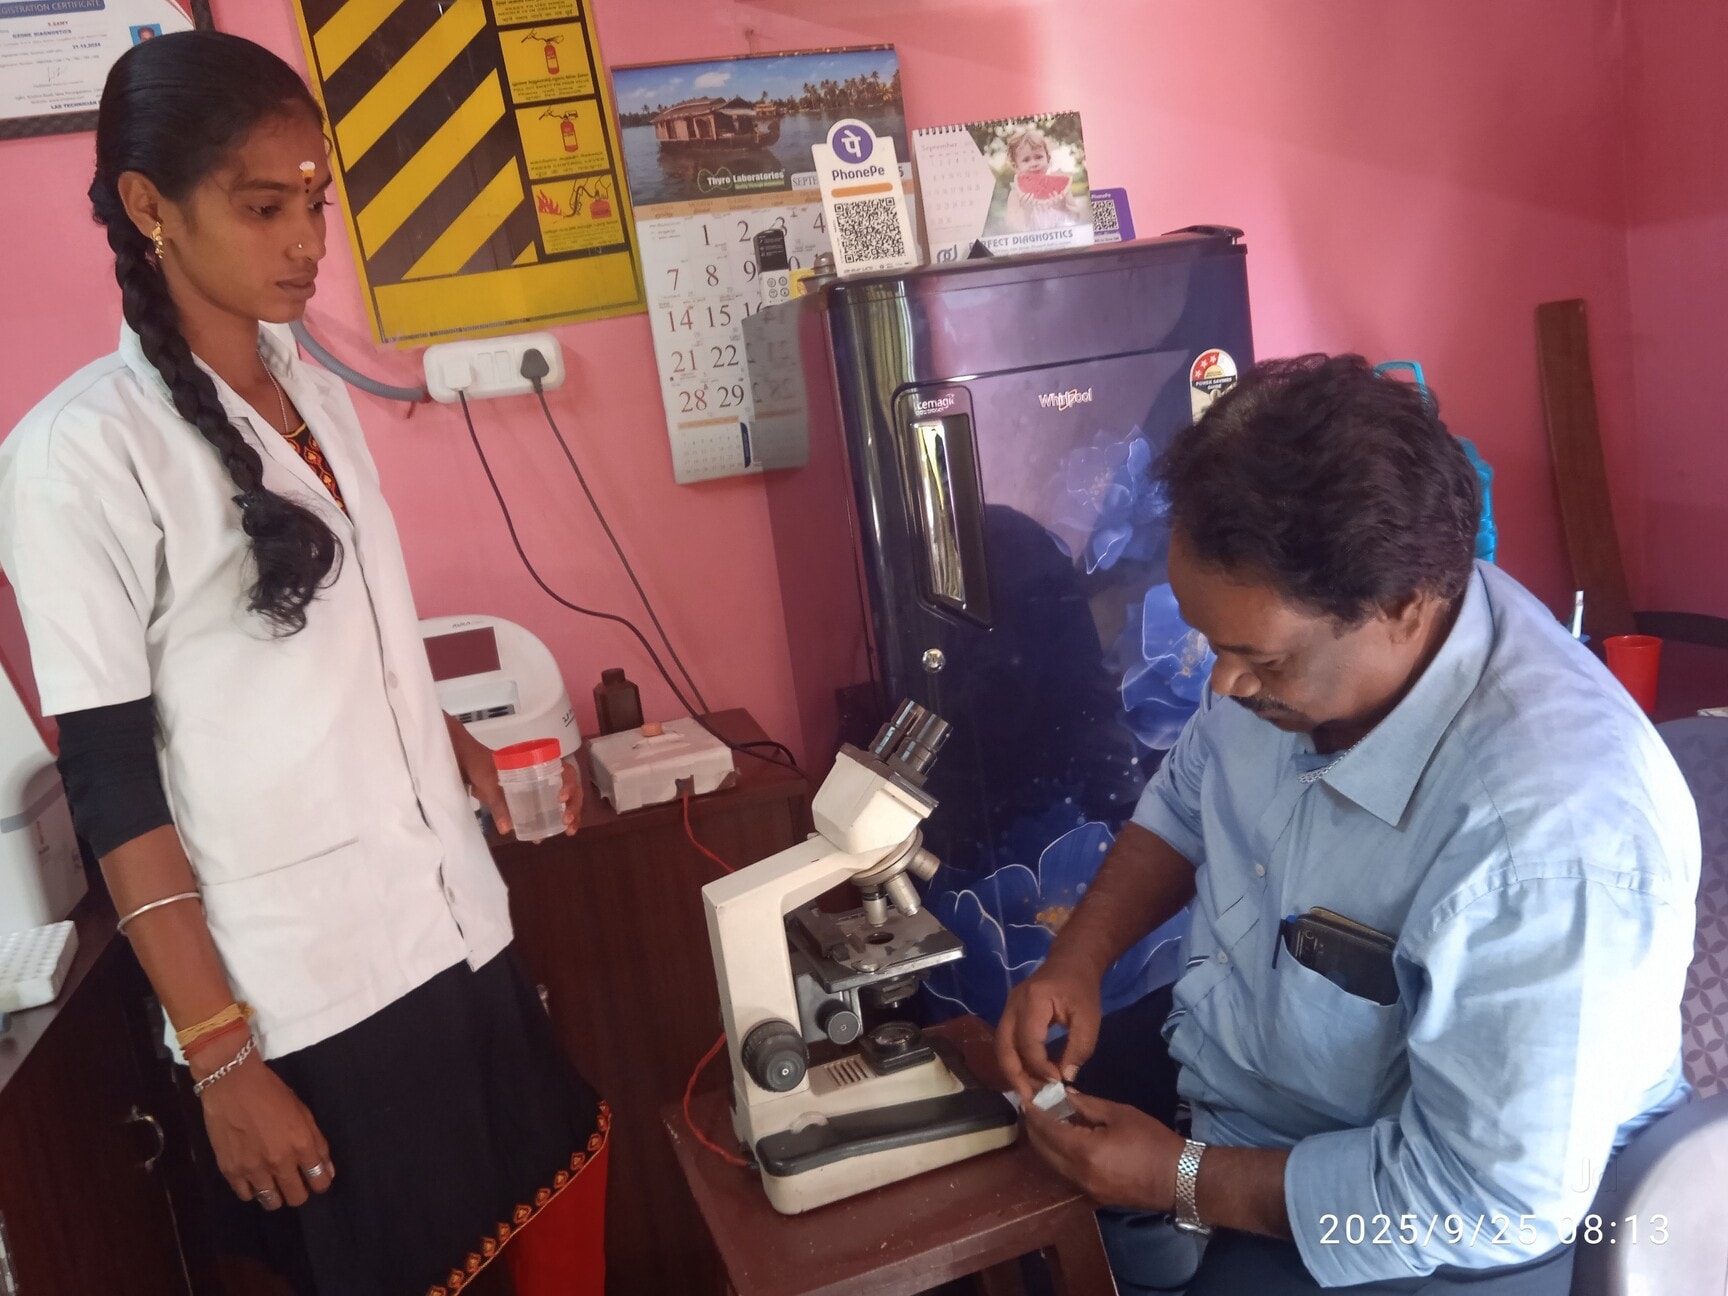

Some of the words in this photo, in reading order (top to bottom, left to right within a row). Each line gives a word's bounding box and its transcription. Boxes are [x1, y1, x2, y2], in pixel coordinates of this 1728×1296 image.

[706, 176, 731, 186] Thyro
[733, 171, 784, 183] Laboratories
[831, 165, 885, 181] PhonePe
[702, 224, 710, 246] 1
[737, 220, 751, 243] 2
[813, 212, 826, 234] 4
[1012, 229, 1073, 245] DIAGNOSTICS
[667, 268, 679, 291] 7
[706, 264, 719, 287] 8
[743, 260, 756, 282] 9
[669, 308, 694, 332] 14
[706, 304, 731, 328] 15
[671, 349, 696, 373] 21
[710, 344, 739, 368] 22
[679, 388, 707, 413] 28
[716, 384, 744, 408] 29
[1038, 388, 1092, 412] Whirlpool
